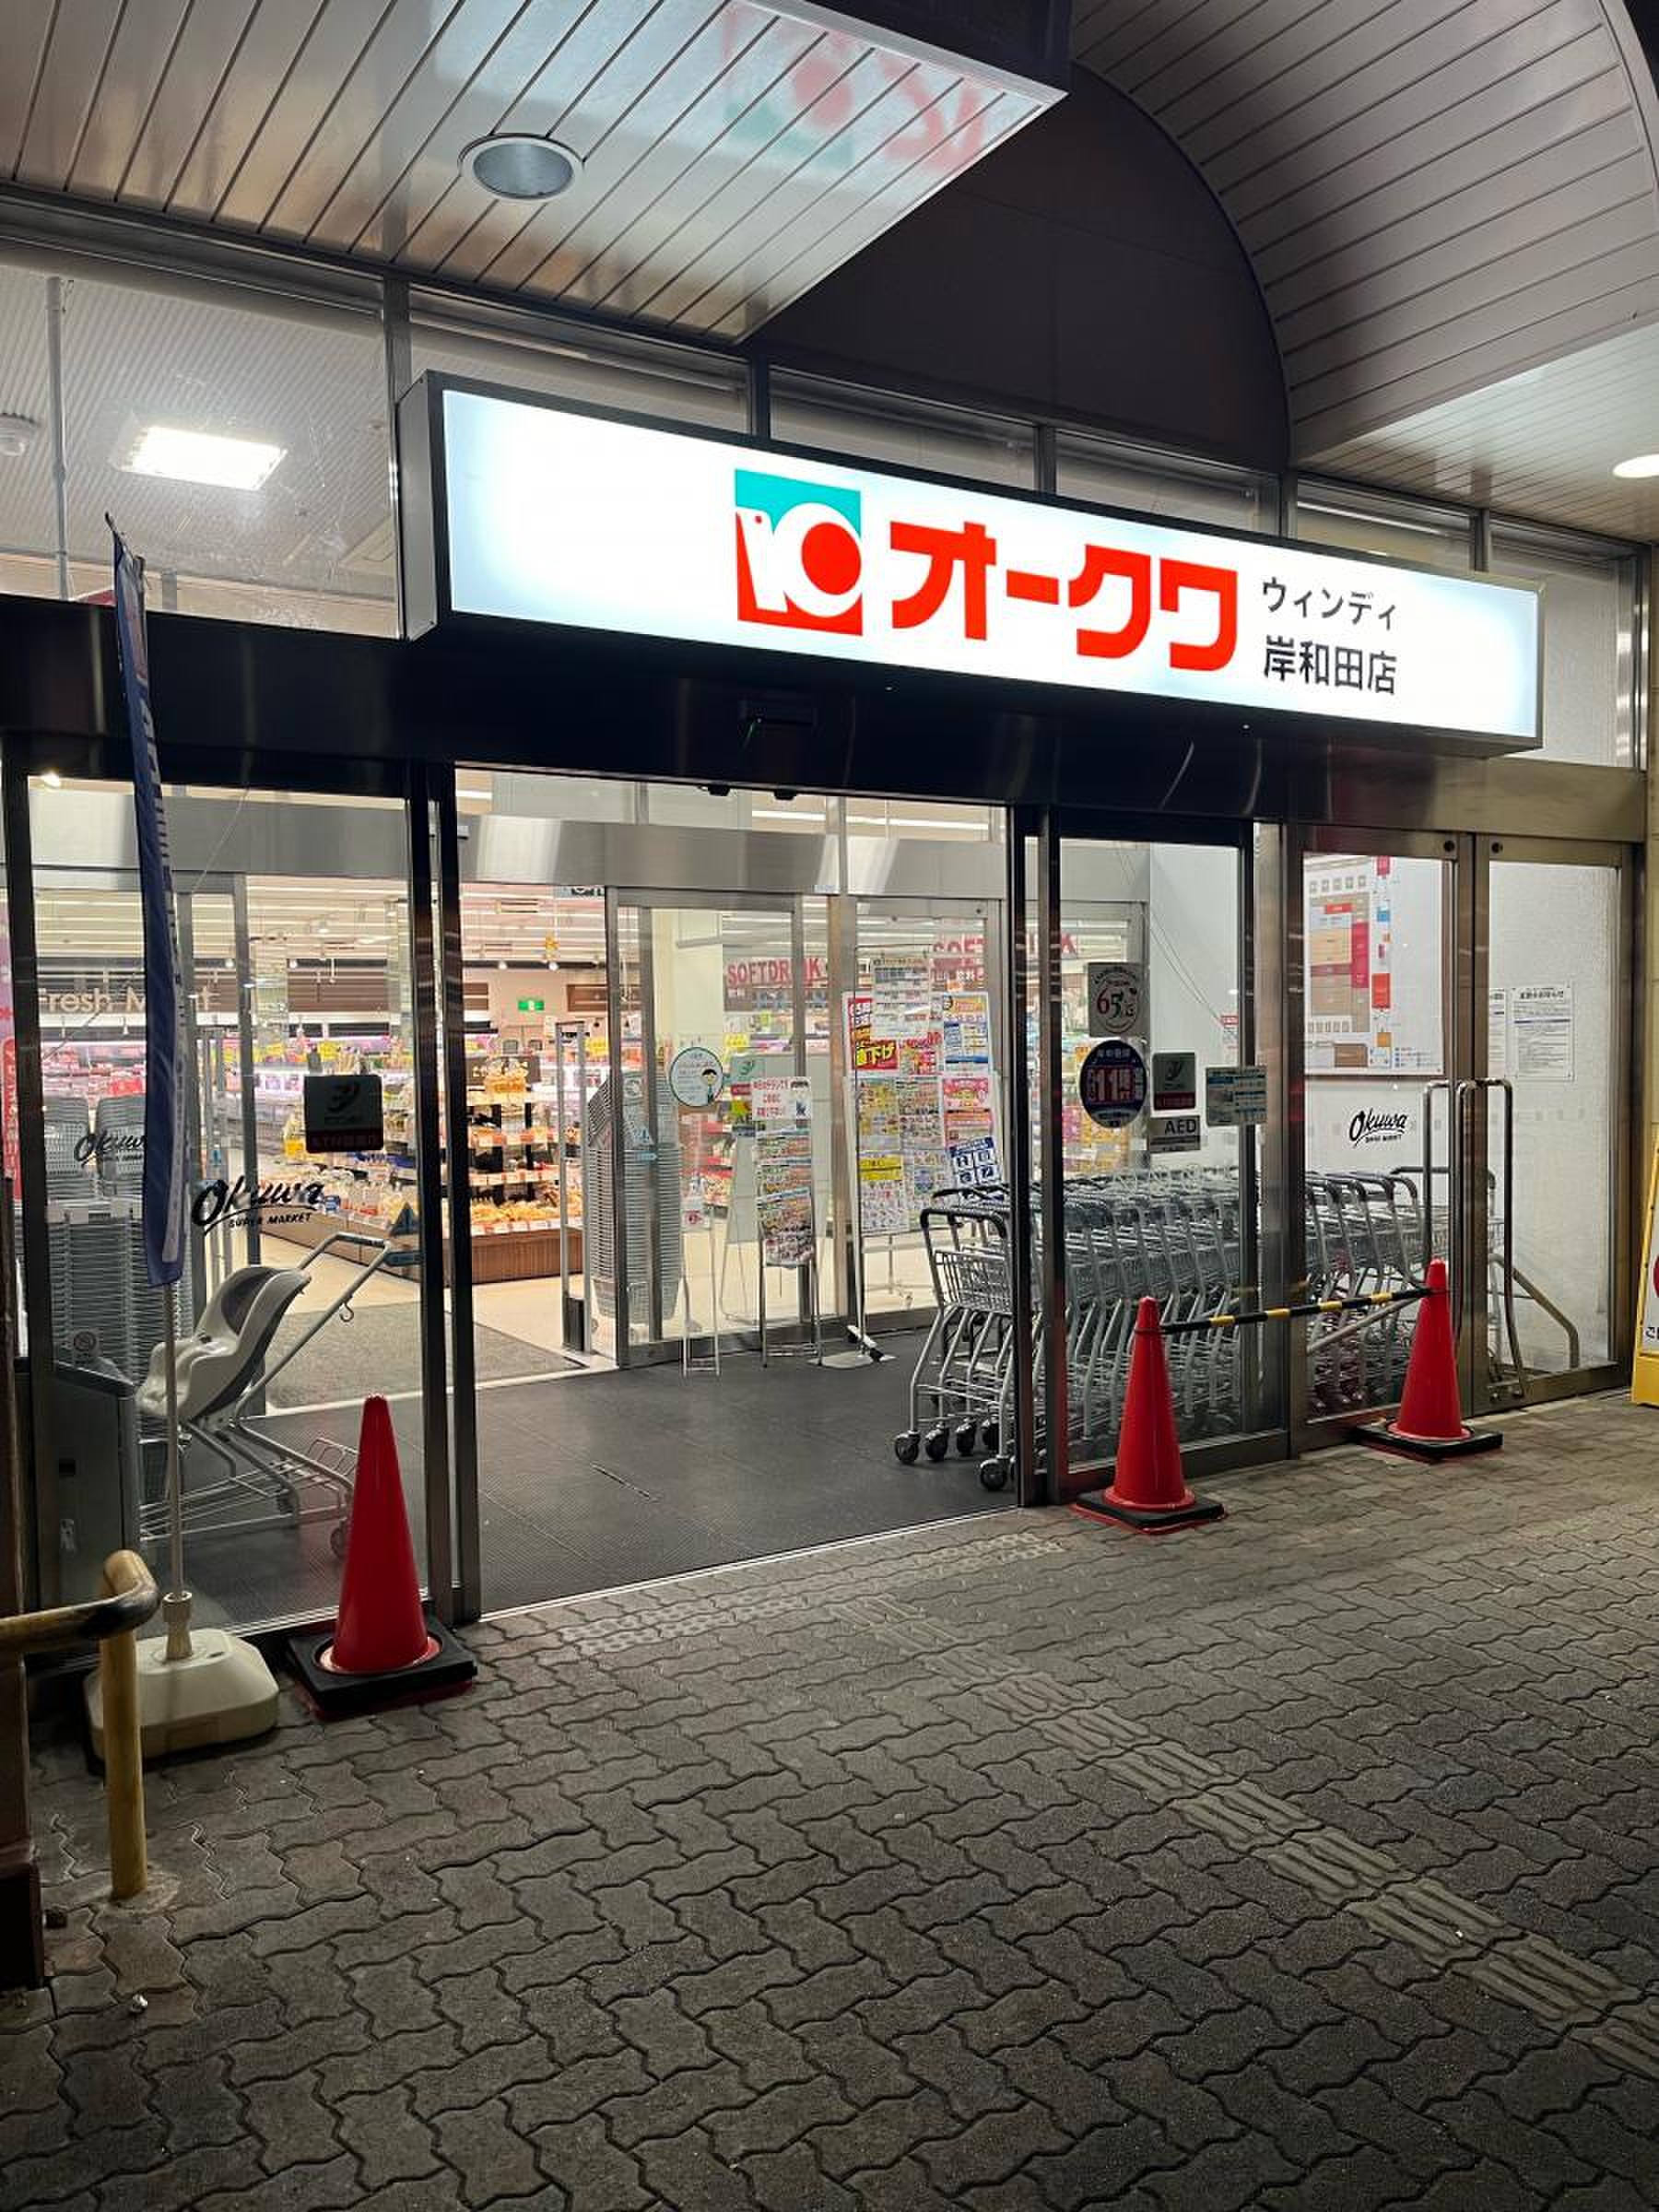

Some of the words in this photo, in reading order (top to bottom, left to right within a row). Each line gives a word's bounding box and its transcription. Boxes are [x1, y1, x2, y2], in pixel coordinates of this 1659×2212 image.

[889, 522, 1238, 671] オークワ
[1261, 576, 1397, 631] ウィンディ
[1263, 635, 1397, 694] 岸和田店
[1164, 1119, 1197, 1135] AED
[1348, 1107, 1408, 1143] Okuwa
[191, 1174, 325, 1230] Okuwa
